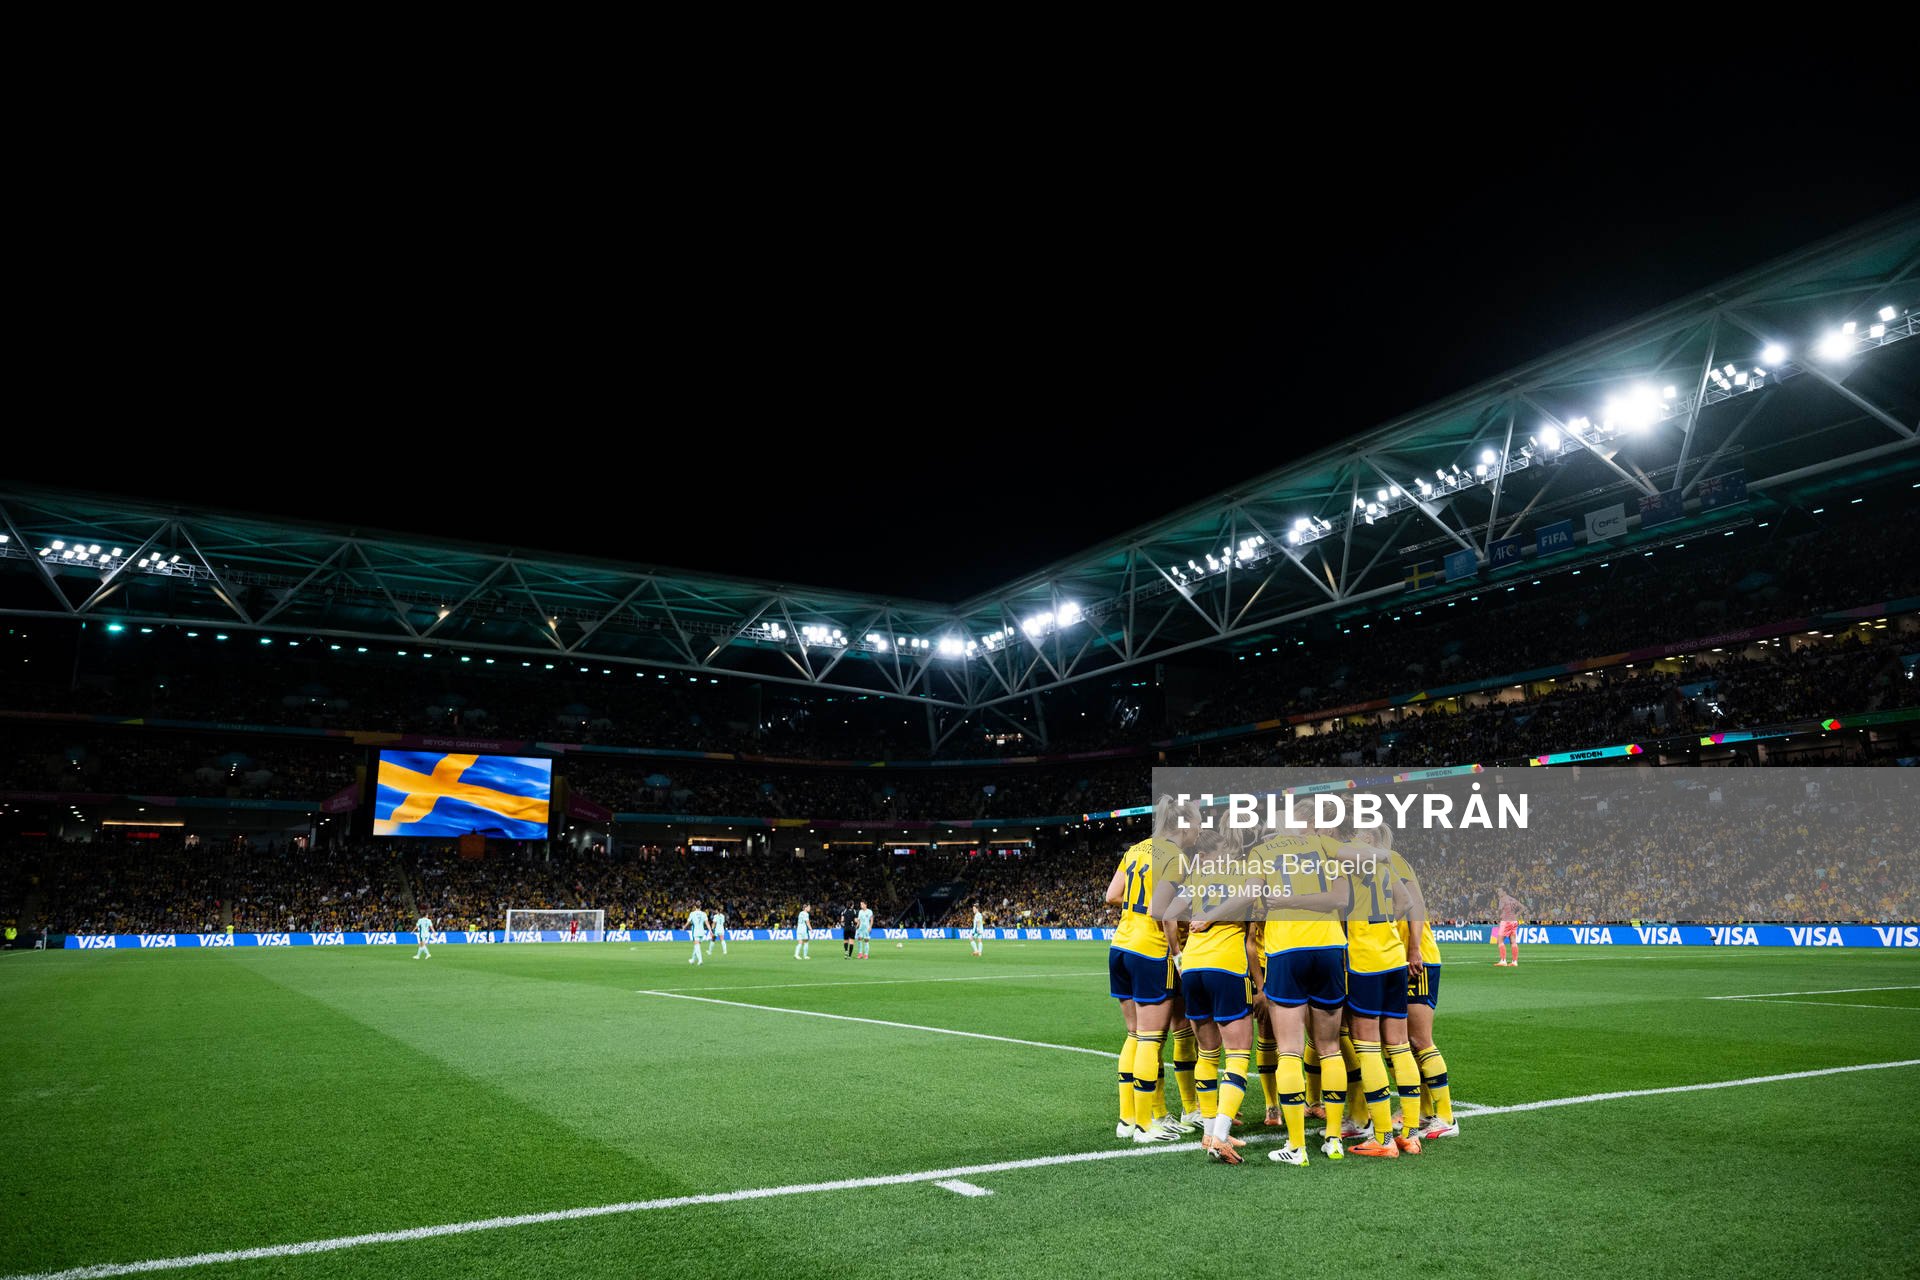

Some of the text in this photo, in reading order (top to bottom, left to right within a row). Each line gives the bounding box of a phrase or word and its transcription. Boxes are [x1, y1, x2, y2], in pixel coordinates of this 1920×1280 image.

[1541, 531, 1568, 548] FIFA
[1493, 544, 1517, 562] AFC
[1569, 750, 1603, 761] SWEDEN
[1425, 769, 1453, 778] SWEDEN
[1122, 860, 1149, 915] 11
[309, 933, 345, 945] VISA
[361, 932, 397, 944] VISA
[413, 932, 447, 944] VSA
[511, 931, 542, 943] VISA
[645, 930, 674, 942] VISA
[727, 930, 754, 941] VISA
[767, 929, 794, 940] VISA
[808, 929, 833, 940] VISA
[882, 928, 909, 939] VISA
[920, 928, 946, 938] VISA
[1002, 928, 1019, 939] VISA
[1026, 928, 1042, 939] VISA
[1050, 928, 1067, 939] VISA
[1074, 928, 1093, 940] VISA
[1101, 928, 1116, 940] VIS
[1568, 927, 1613, 944] VISA
[1634, 927, 1683, 945] VISA
[1705, 927, 1760, 945] VISA
[1784, 927, 1844, 947] VISA
[1871, 926, 1920, 947] VIS
[75, 935, 116, 949] VISA
[137, 934, 177, 948] VISA
[197, 934, 235, 947] VISA
[253, 933, 291, 946] VISA
